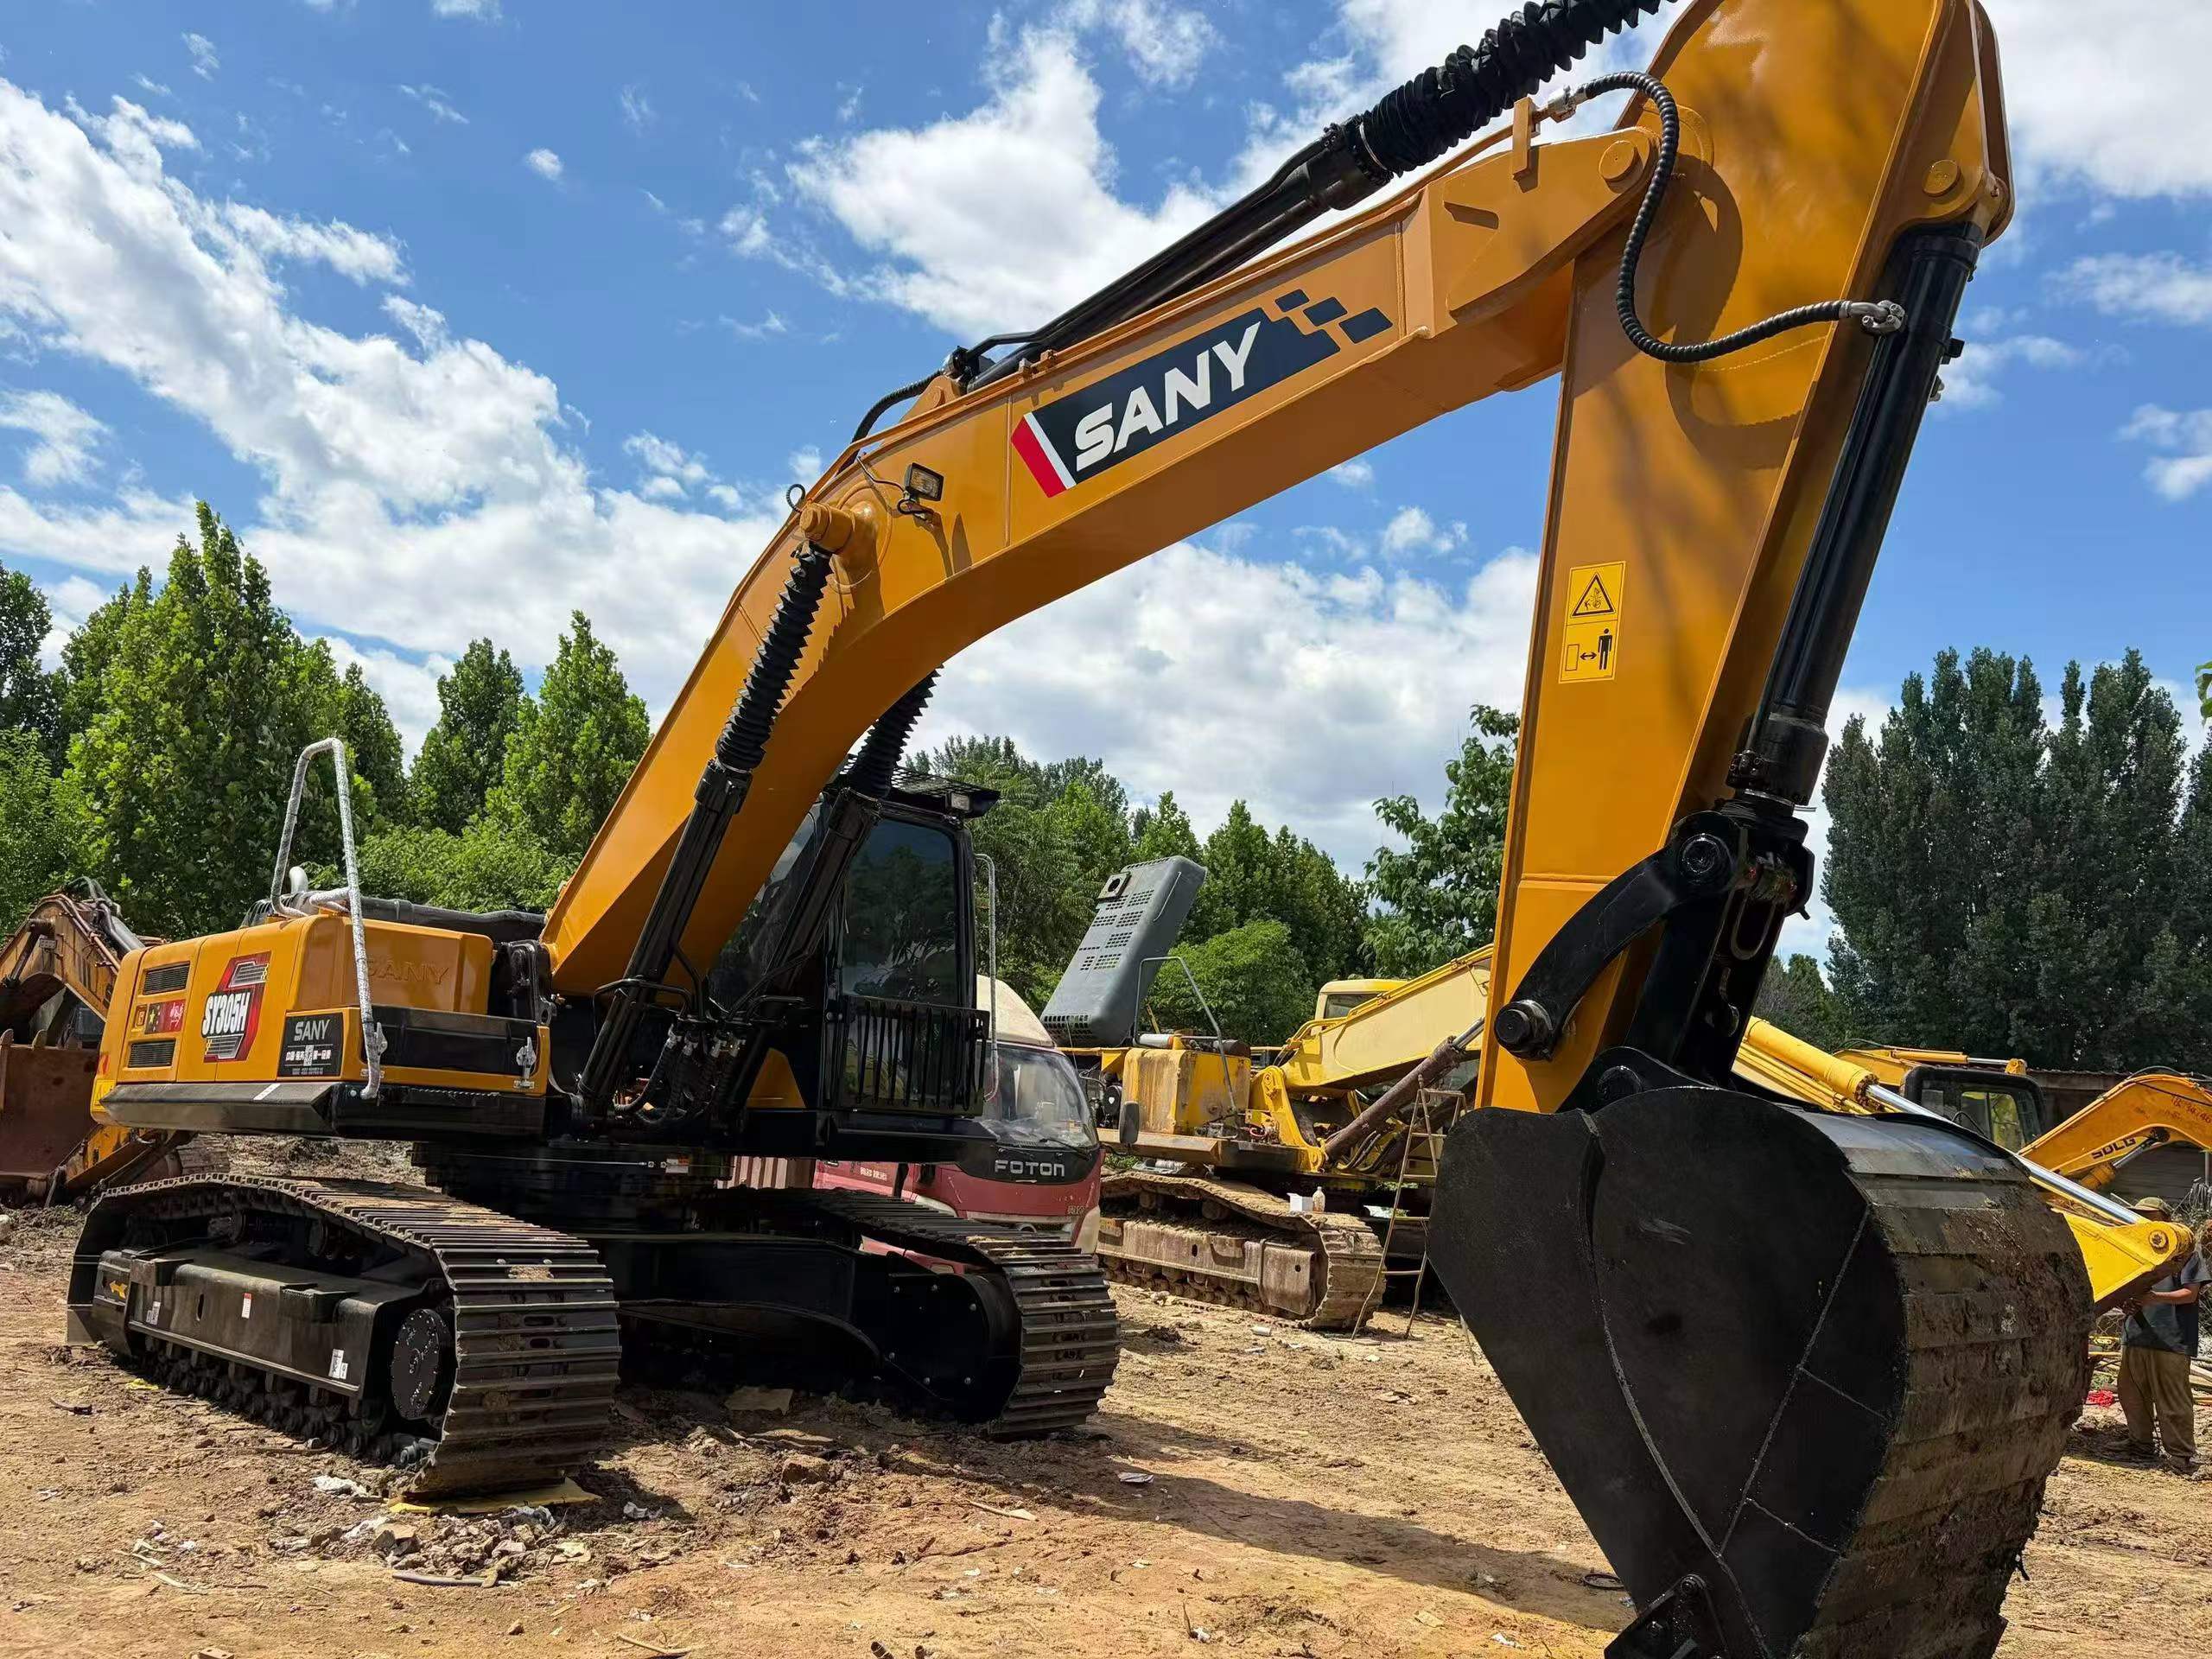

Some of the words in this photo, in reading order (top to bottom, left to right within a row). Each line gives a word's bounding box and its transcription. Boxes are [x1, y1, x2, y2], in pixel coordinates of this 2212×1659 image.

[1074, 321, 1262, 473] SANY
[294, 1020, 330, 1041] SANY
[995, 1160, 1065, 1177] FOTON
